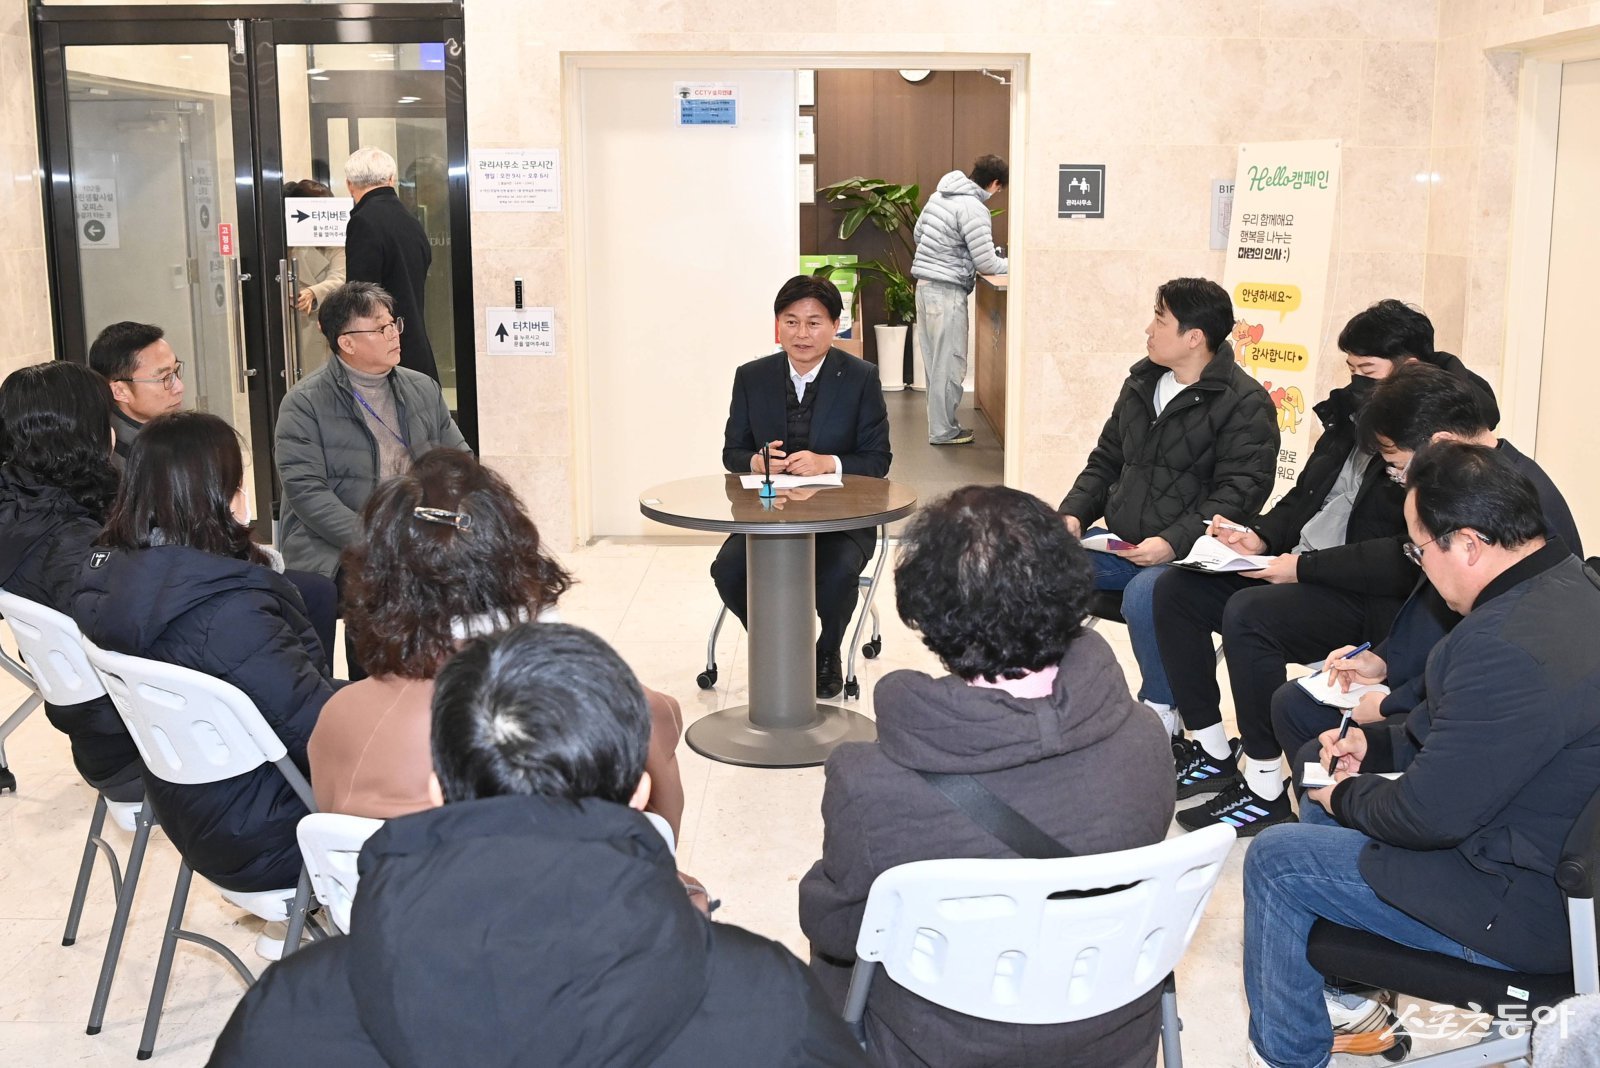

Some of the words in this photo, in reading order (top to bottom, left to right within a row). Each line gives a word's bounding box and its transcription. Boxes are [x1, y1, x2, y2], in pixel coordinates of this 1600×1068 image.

[479, 160, 519, 170] 관리사무소
[521, 160, 553, 170] 근무시간
[1219, 185, 1235, 194] B1F
[81, 203, 104, 211] 오피스
[311, 210, 348, 222] 터치버튼
[1242, 213, 1259, 227] 우리
[1260, 213, 1294, 227] 함께해요
[1240, 230, 1266, 244] 행복을
[1266, 230, 1292, 244] 나누는
[1237, 246, 1264, 260] 마법의
[1264, 247, 1282, 260] 인사
[1242, 288, 1292, 303] 안녕하세요~
[512, 321, 551, 332] 터치버튼
[1252, 347, 1297, 363] 감사합니다
[1279, 448, 1297, 464] 말로
